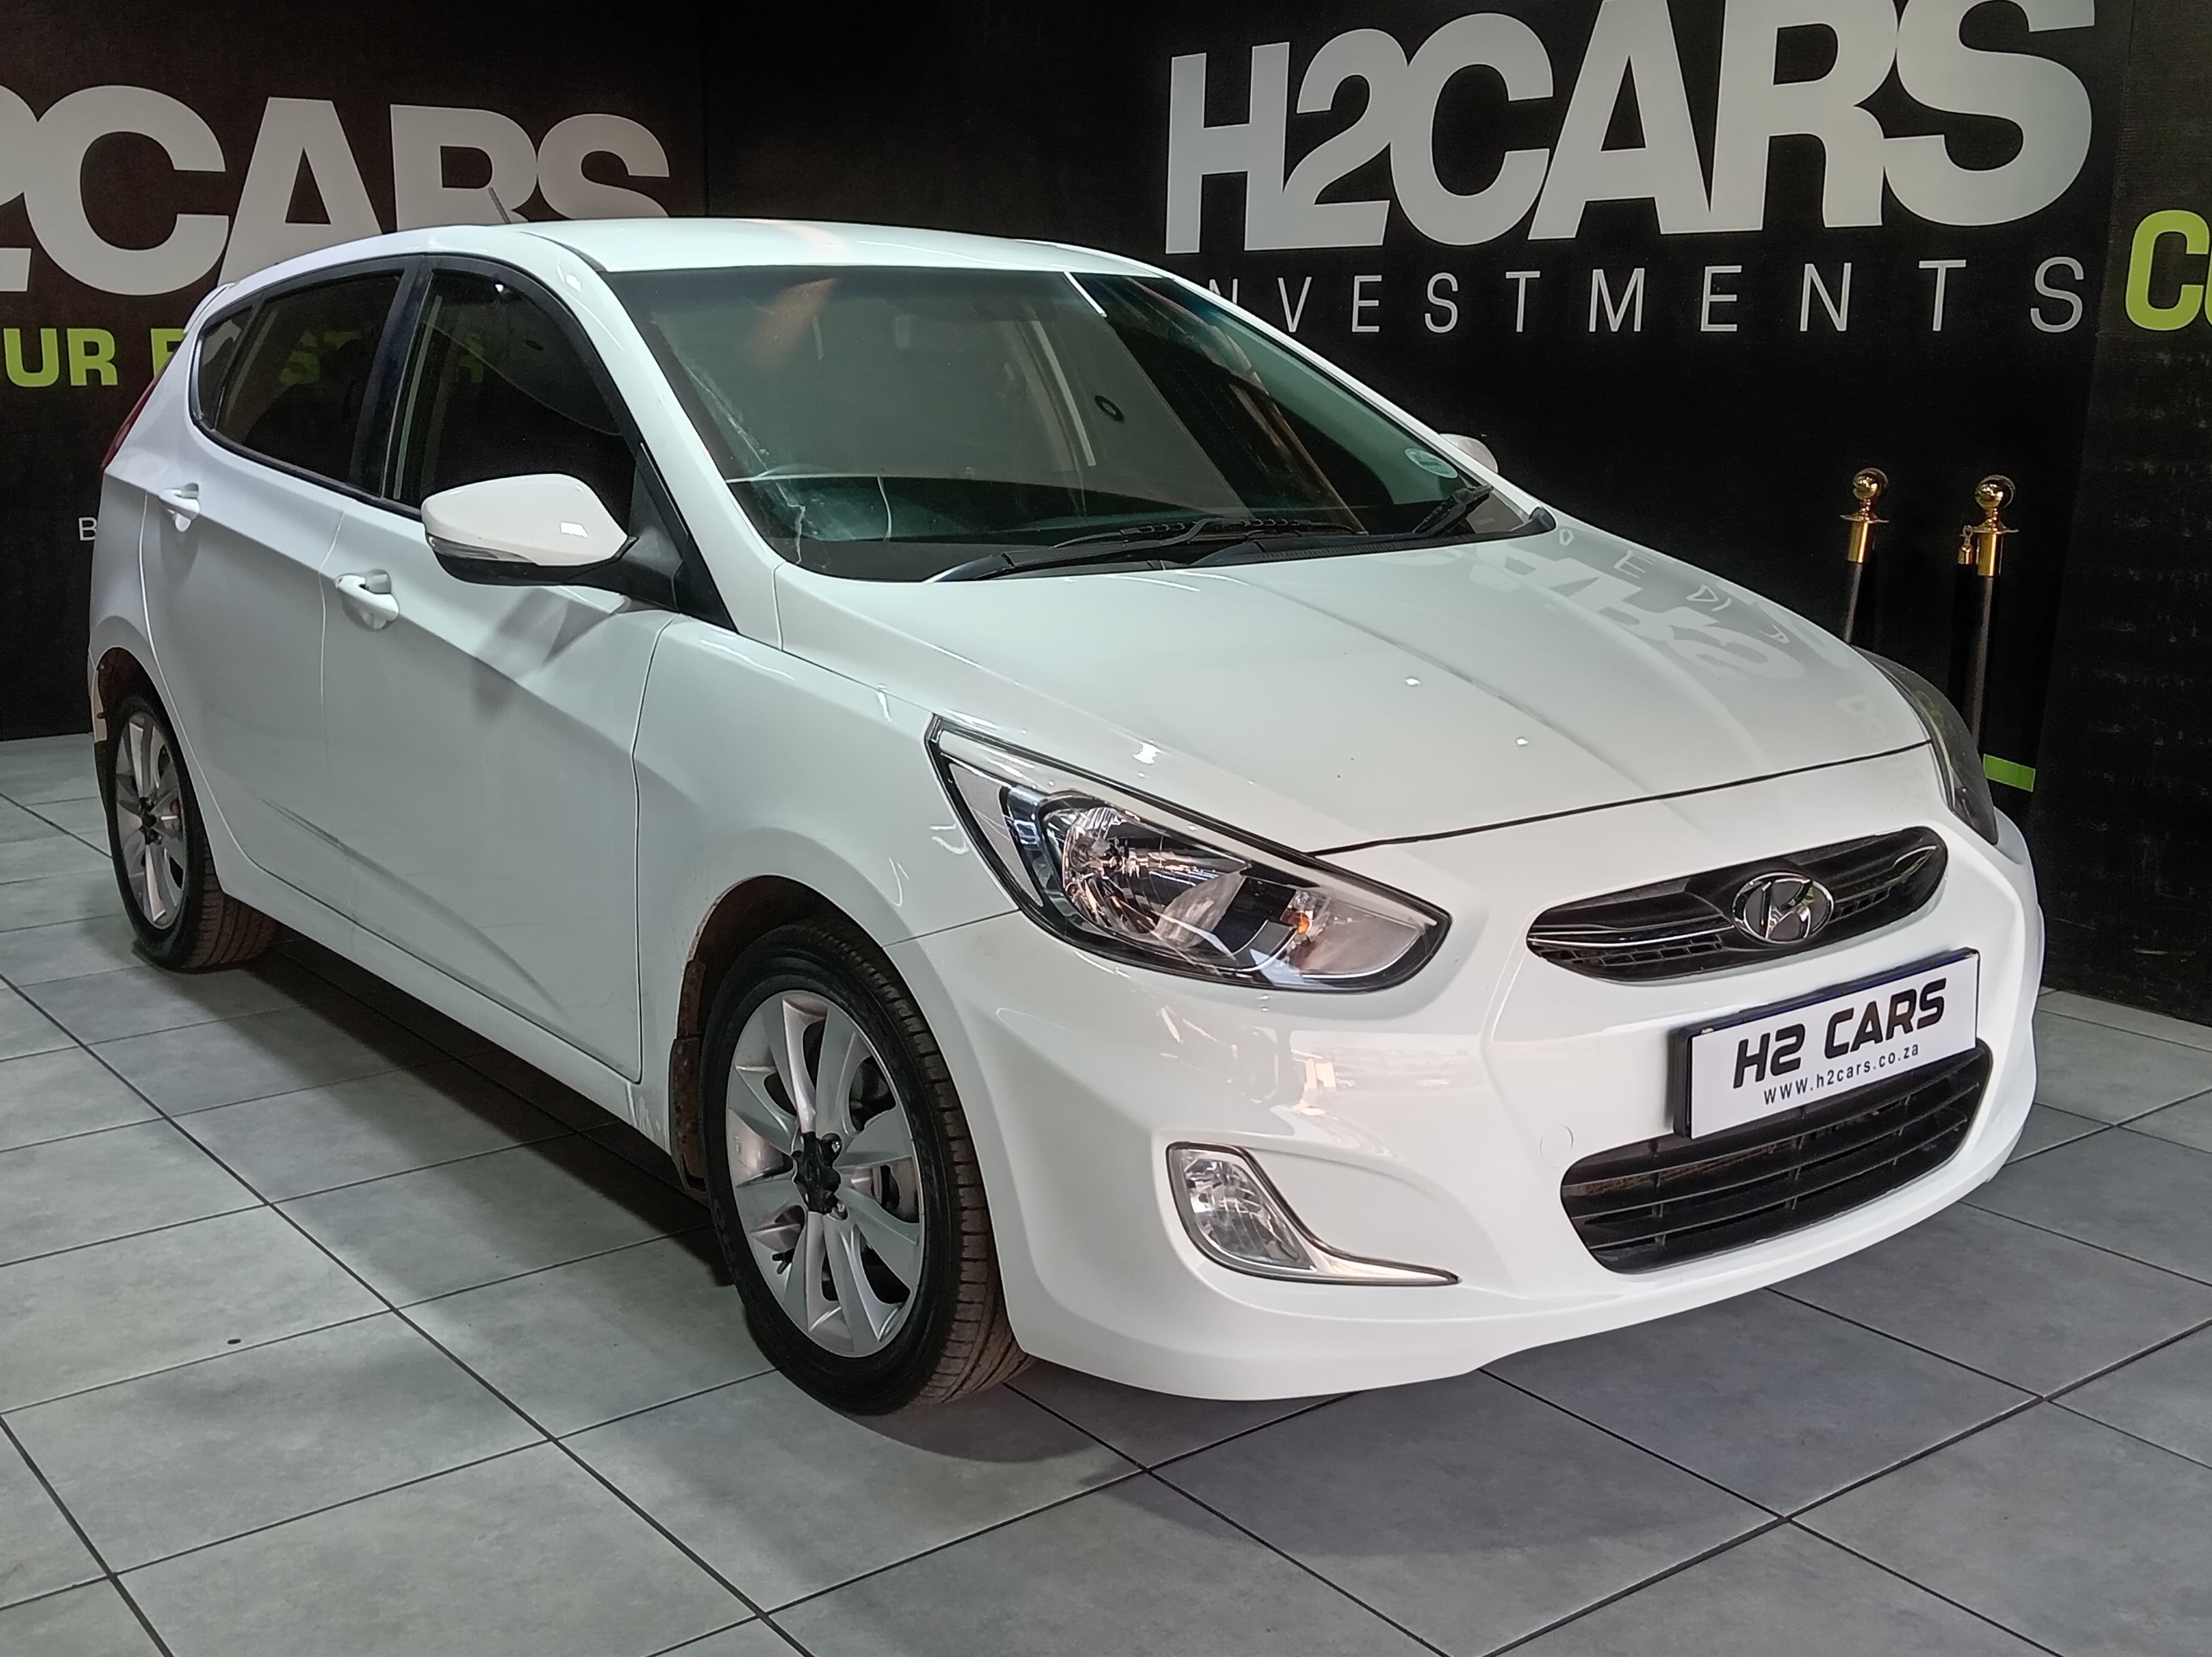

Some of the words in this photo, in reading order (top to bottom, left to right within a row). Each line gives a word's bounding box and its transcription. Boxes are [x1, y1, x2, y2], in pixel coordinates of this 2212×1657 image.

[0, 85, 670, 296] CARS
[1165, 0, 2095, 255] H2CARS
[1733, 1023, 1805, 1090] H2
[1824, 978, 1947, 1059] CARS
[1764, 1044, 1919, 1105] www.h2cars.co.za
